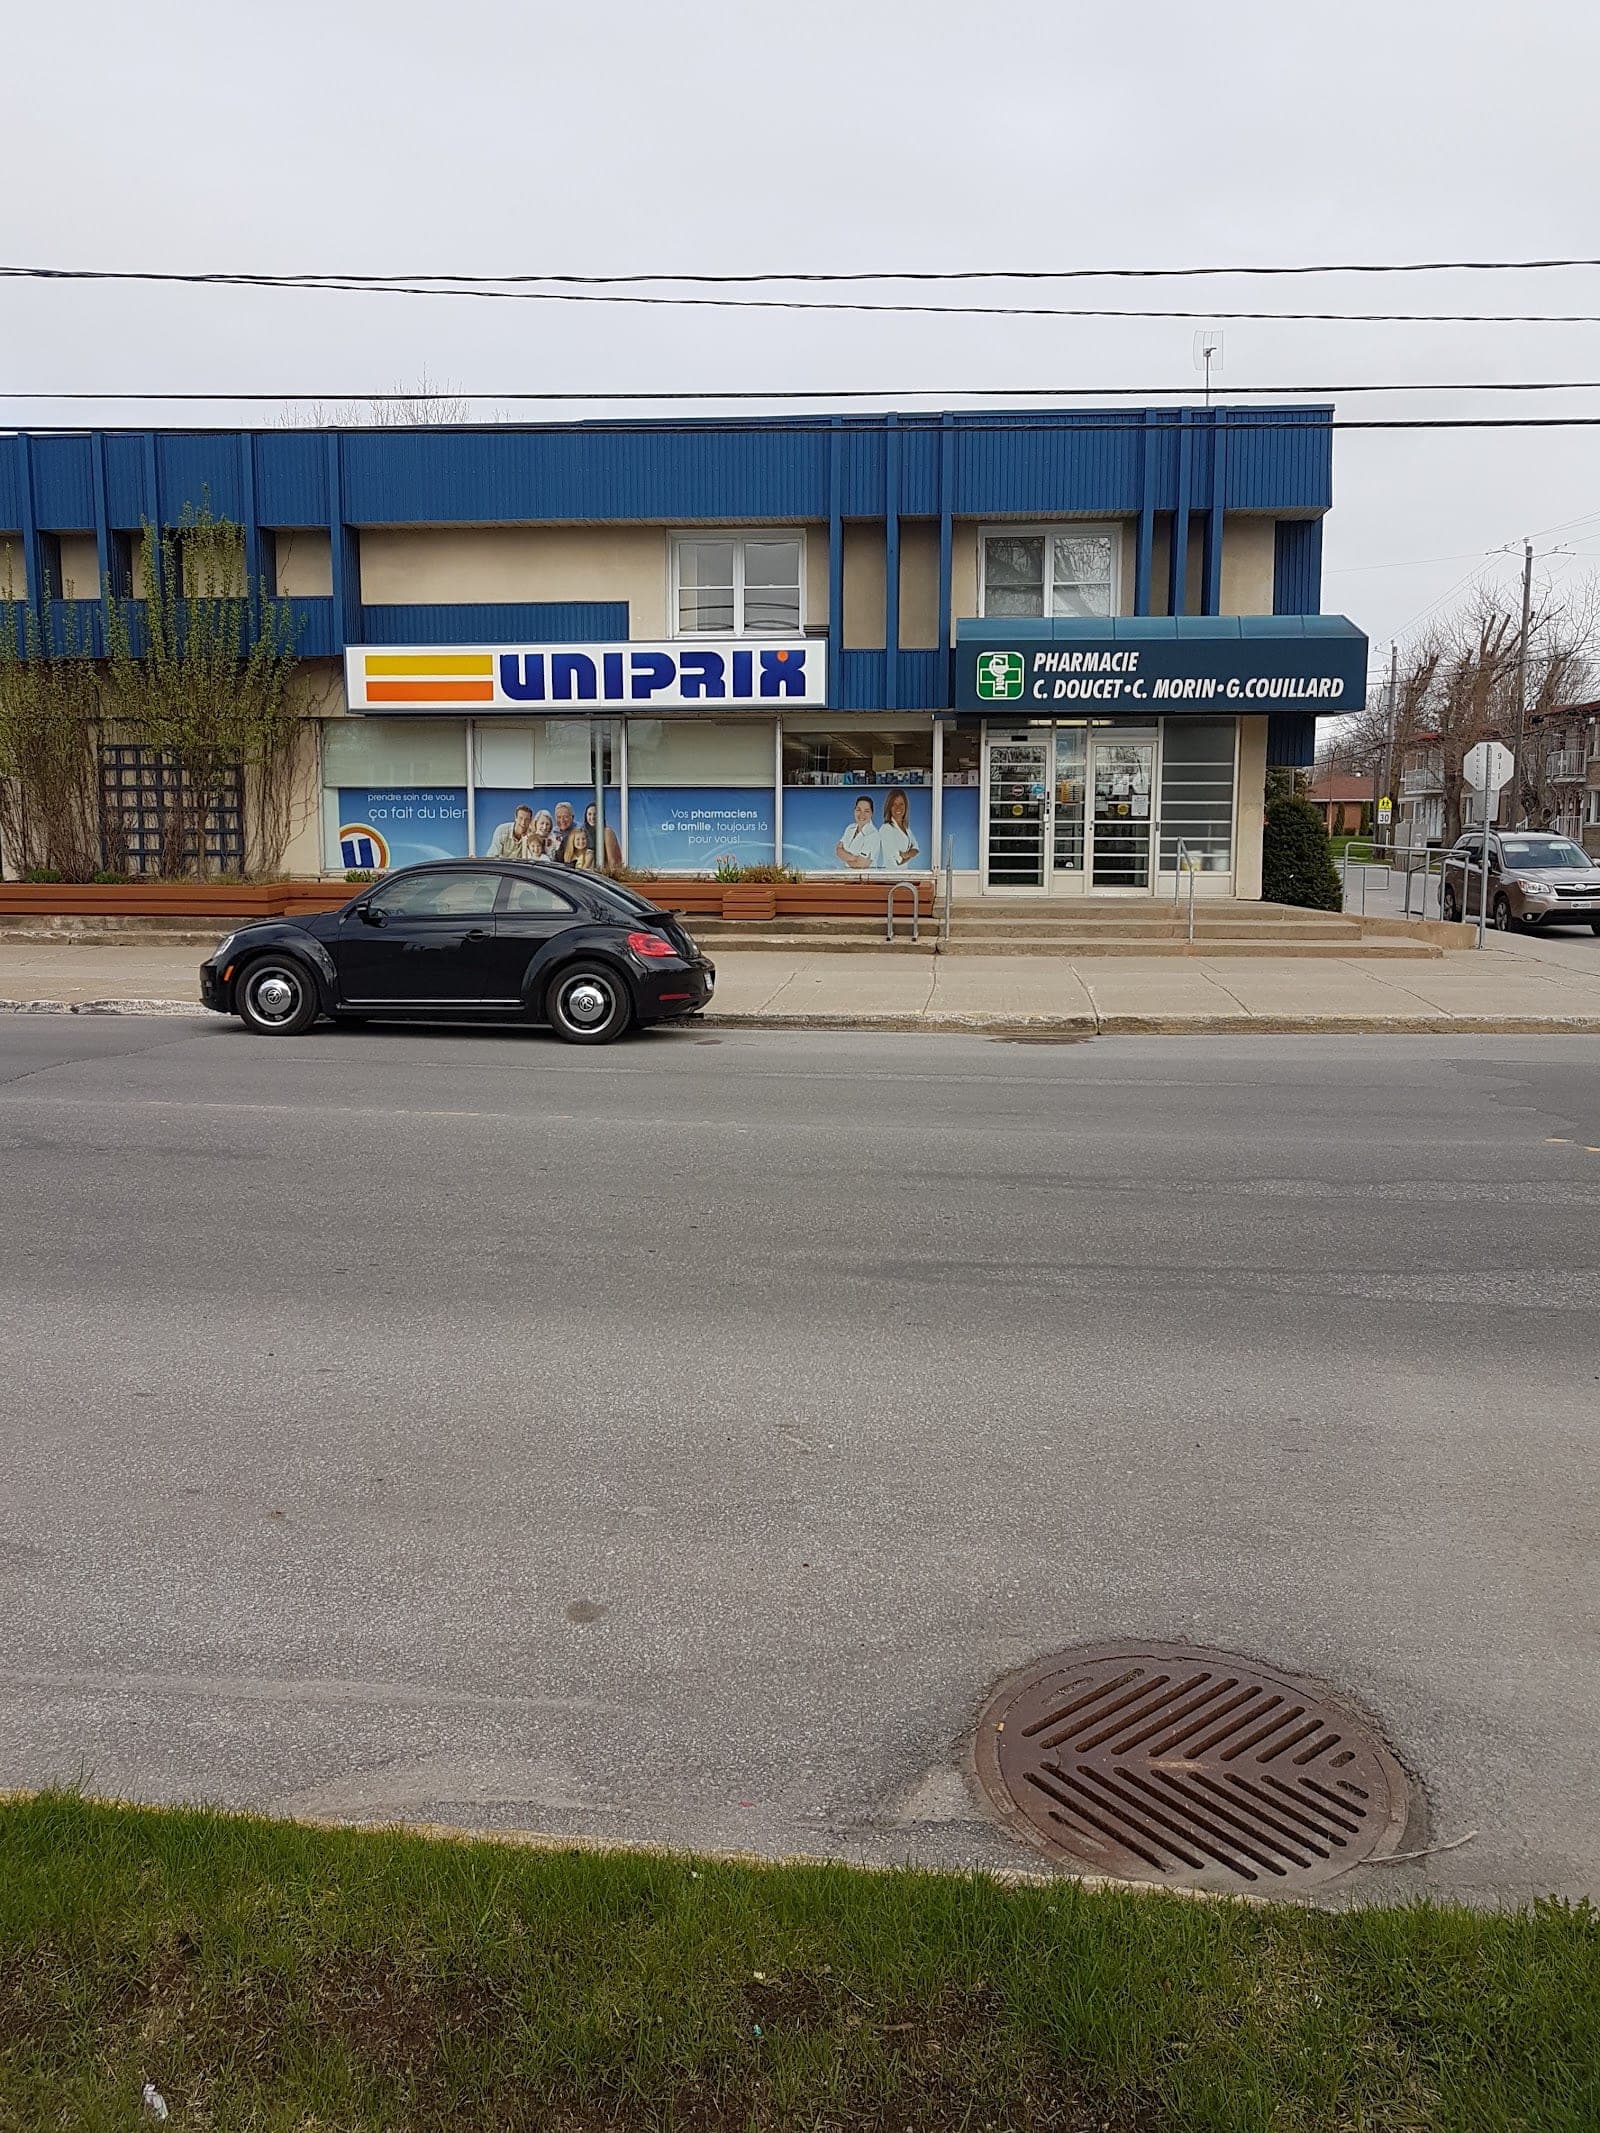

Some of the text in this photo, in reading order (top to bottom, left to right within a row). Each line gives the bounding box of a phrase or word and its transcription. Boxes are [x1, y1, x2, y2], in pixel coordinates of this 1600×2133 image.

[1032, 651, 1140, 672] PHARMACIE
[499, 649, 806, 701] UNIPRIX
[1032, 679, 1048, 699] C.
[367, 793, 455, 802] prendre soin de vous
[368, 808, 388, 821] ça
[391, 806, 413, 819] fait
[417, 806, 436, 819] du
[671, 809, 758, 820] Vos pharmaciens
[1379, 813, 1390, 823] 30
[661, 822, 675, 831] de
[717, 822, 756, 832] toujours
[688, 835, 740, 845] pour vous!
